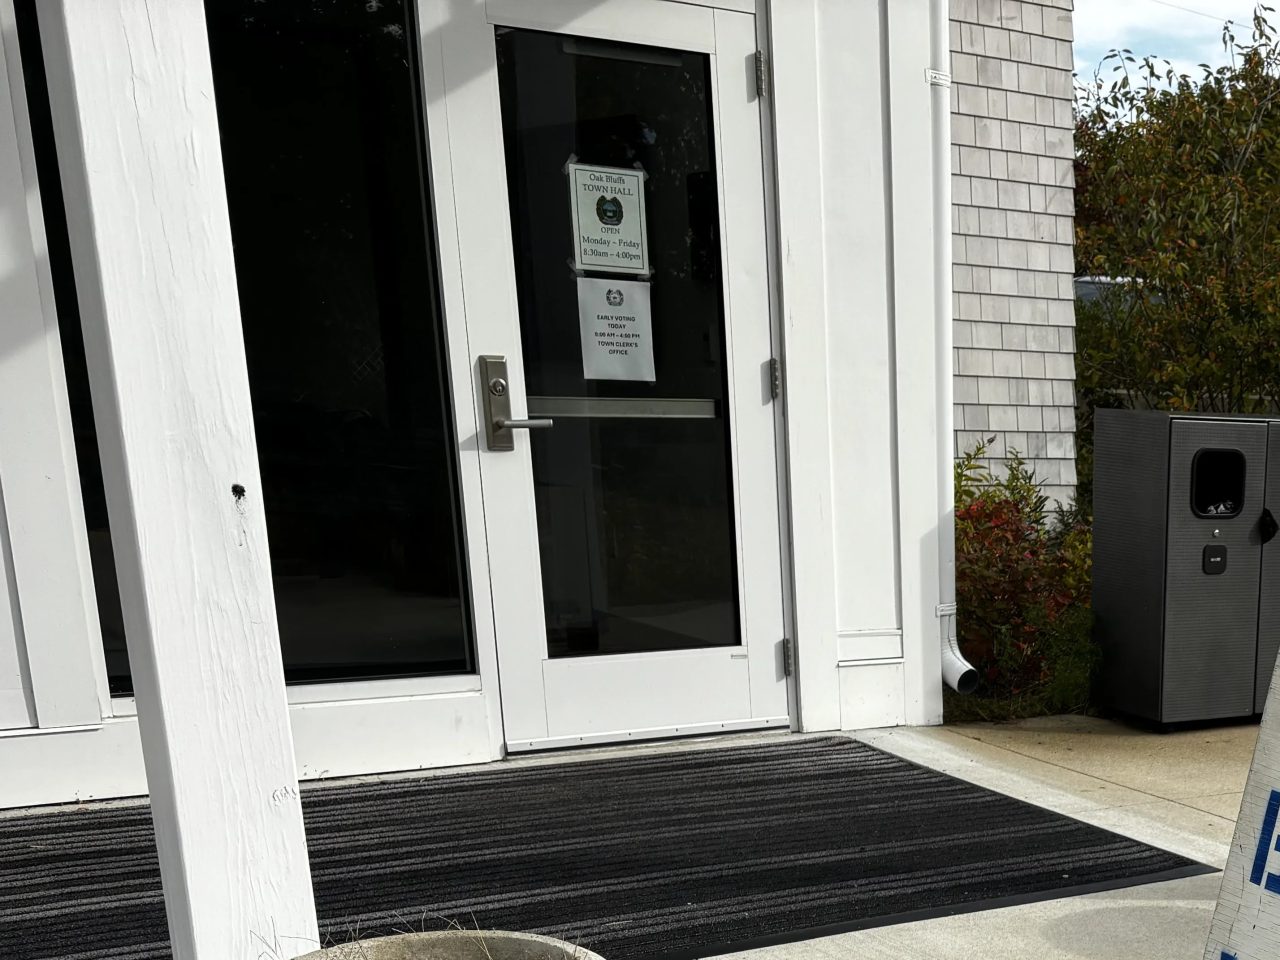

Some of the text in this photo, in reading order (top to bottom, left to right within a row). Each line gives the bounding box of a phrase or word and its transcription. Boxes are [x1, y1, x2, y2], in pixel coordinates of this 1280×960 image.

[589, 173, 626, 184] Oak Bluffs
[582, 183, 634, 196] TOWN HALL
[600, 227, 620, 235] OPEN
[582, 235, 611, 247] Monday
[618, 239, 641, 250] Friday
[583, 248, 609, 258] 8:30am
[615, 250, 641, 261] 4:00pm
